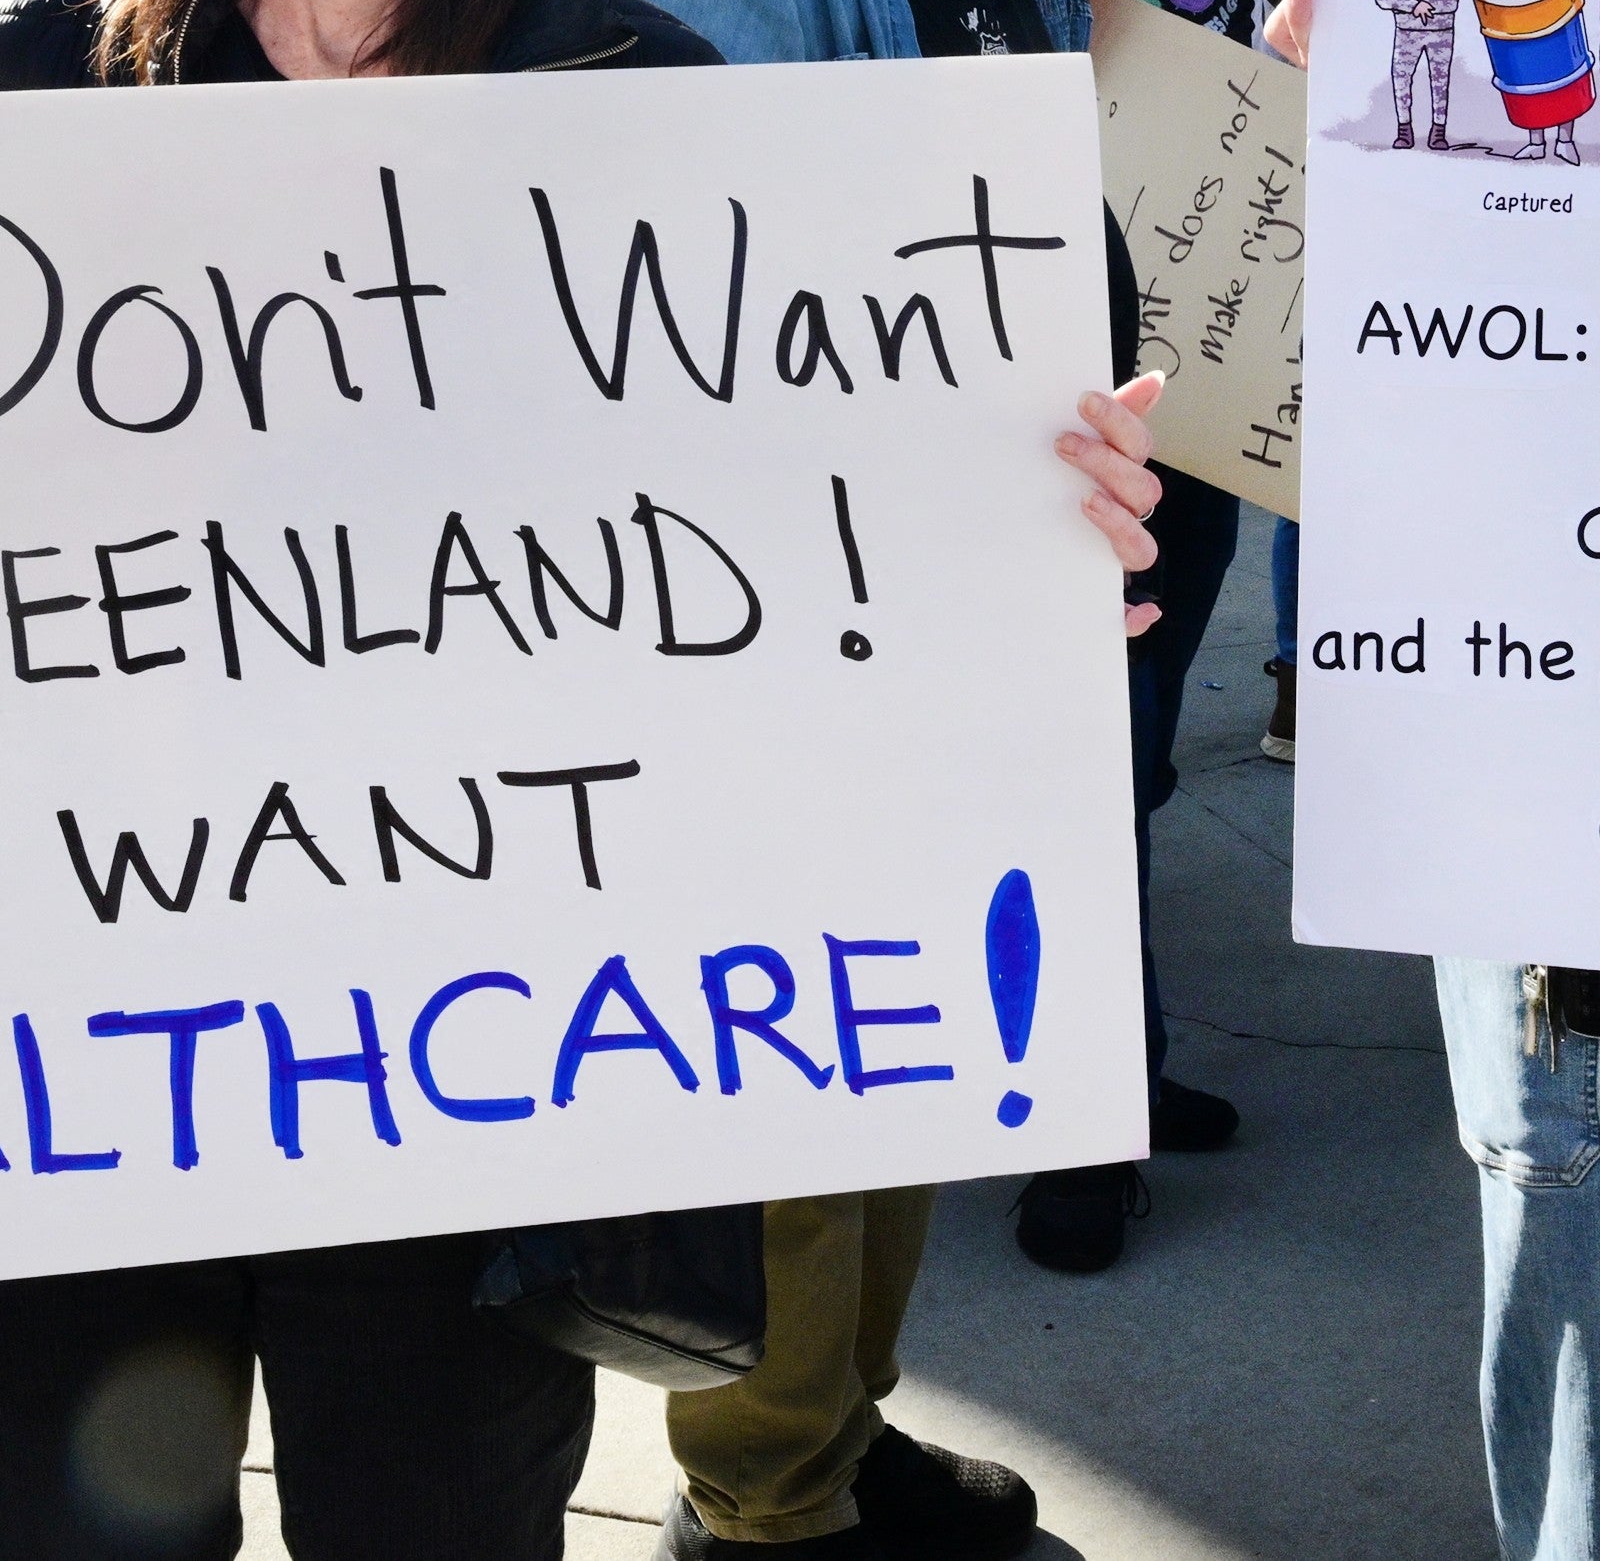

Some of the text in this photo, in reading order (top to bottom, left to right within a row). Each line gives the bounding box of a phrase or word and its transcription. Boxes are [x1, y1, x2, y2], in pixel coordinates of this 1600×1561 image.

[1154, 174, 1224, 264] does
[1221, 69, 1261, 155] not
[1483, 192, 1573, 214] Captured
[529, 174, 1066, 403] Want
[1357, 301, 1587, 361] AWOL:
[1313, 617, 1425, 673] and
[1465, 621, 1575, 680] the
[57, 759, 640, 923] WANT
